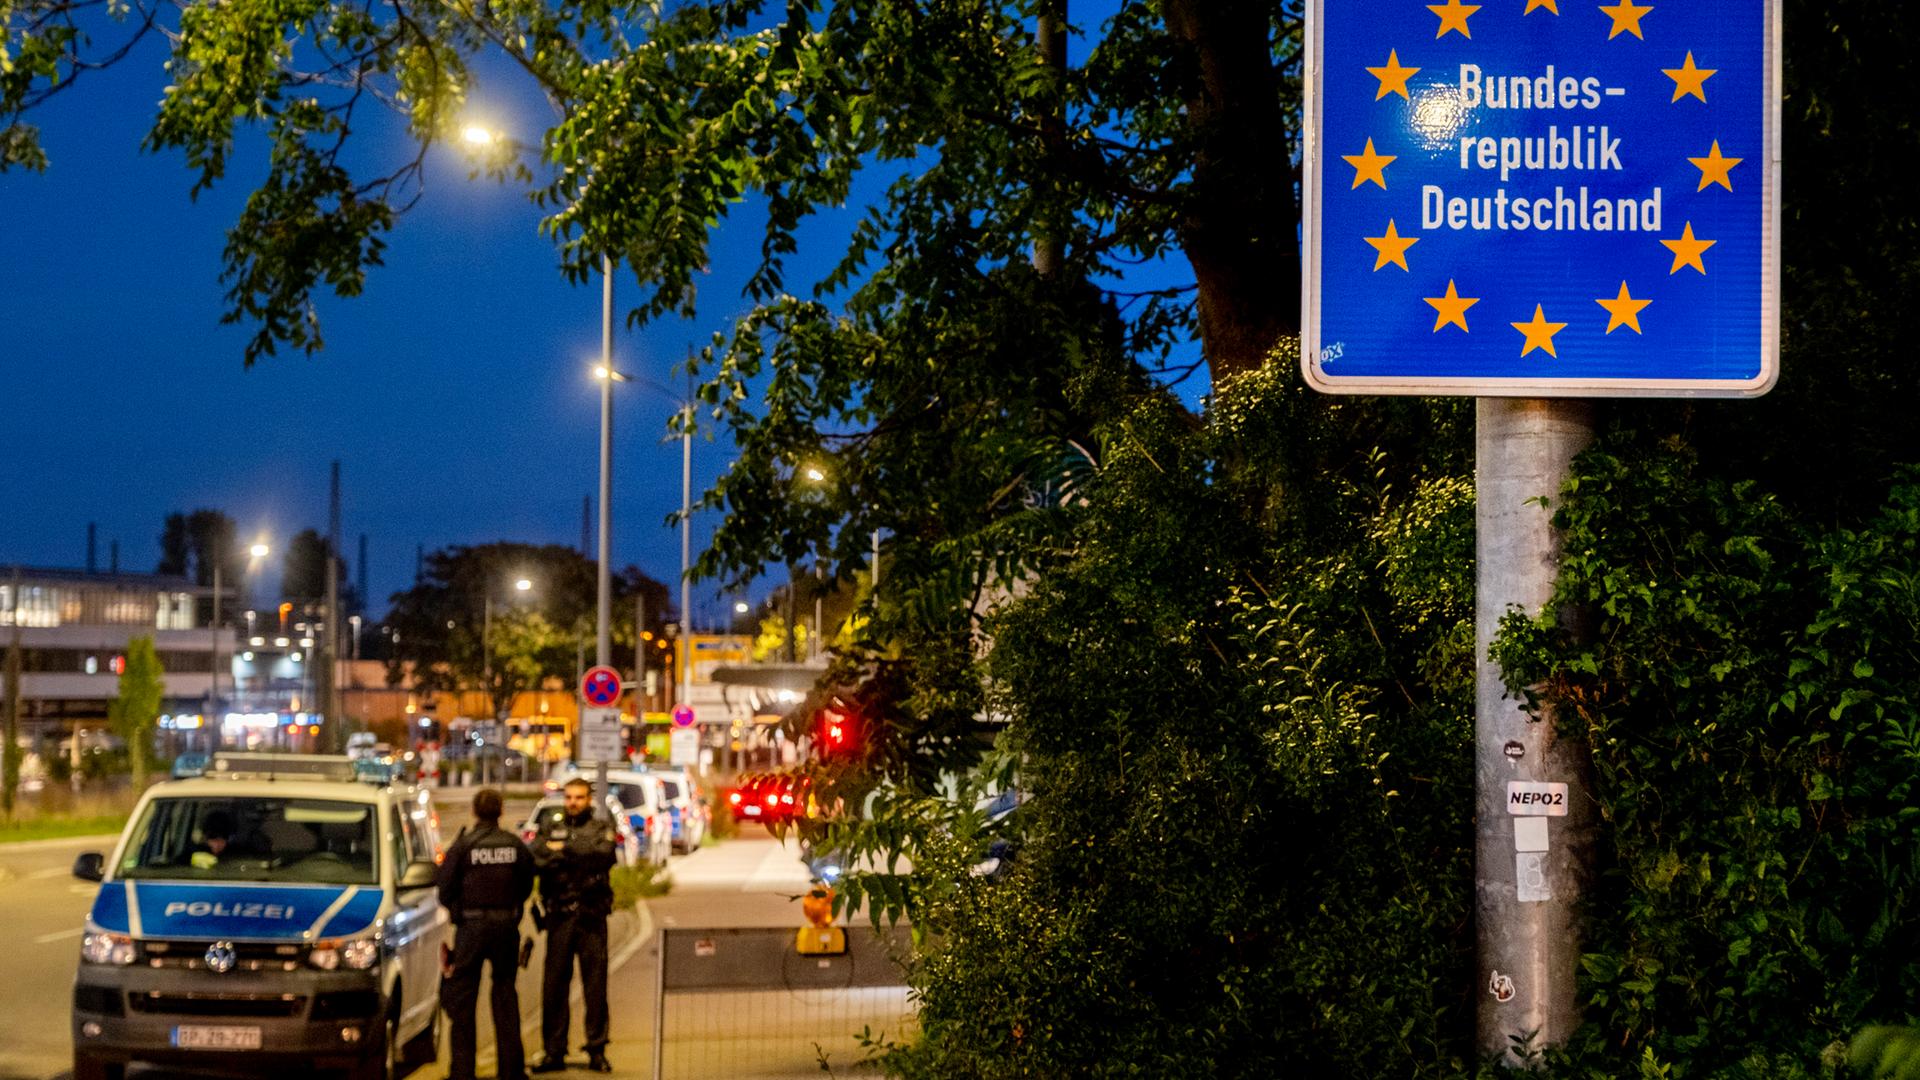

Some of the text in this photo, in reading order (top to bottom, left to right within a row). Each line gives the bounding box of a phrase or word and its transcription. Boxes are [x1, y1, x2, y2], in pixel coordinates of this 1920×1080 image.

[1459, 63, 1626, 109] Bundes-
[1460, 125, 1623, 181] republik
[1422, 185, 1661, 231] Deutschland
[1510, 792, 1563, 805] NEPO2
[471, 847, 517, 865] POLIZEI
[164, 901, 295, 919] POLIZEI
